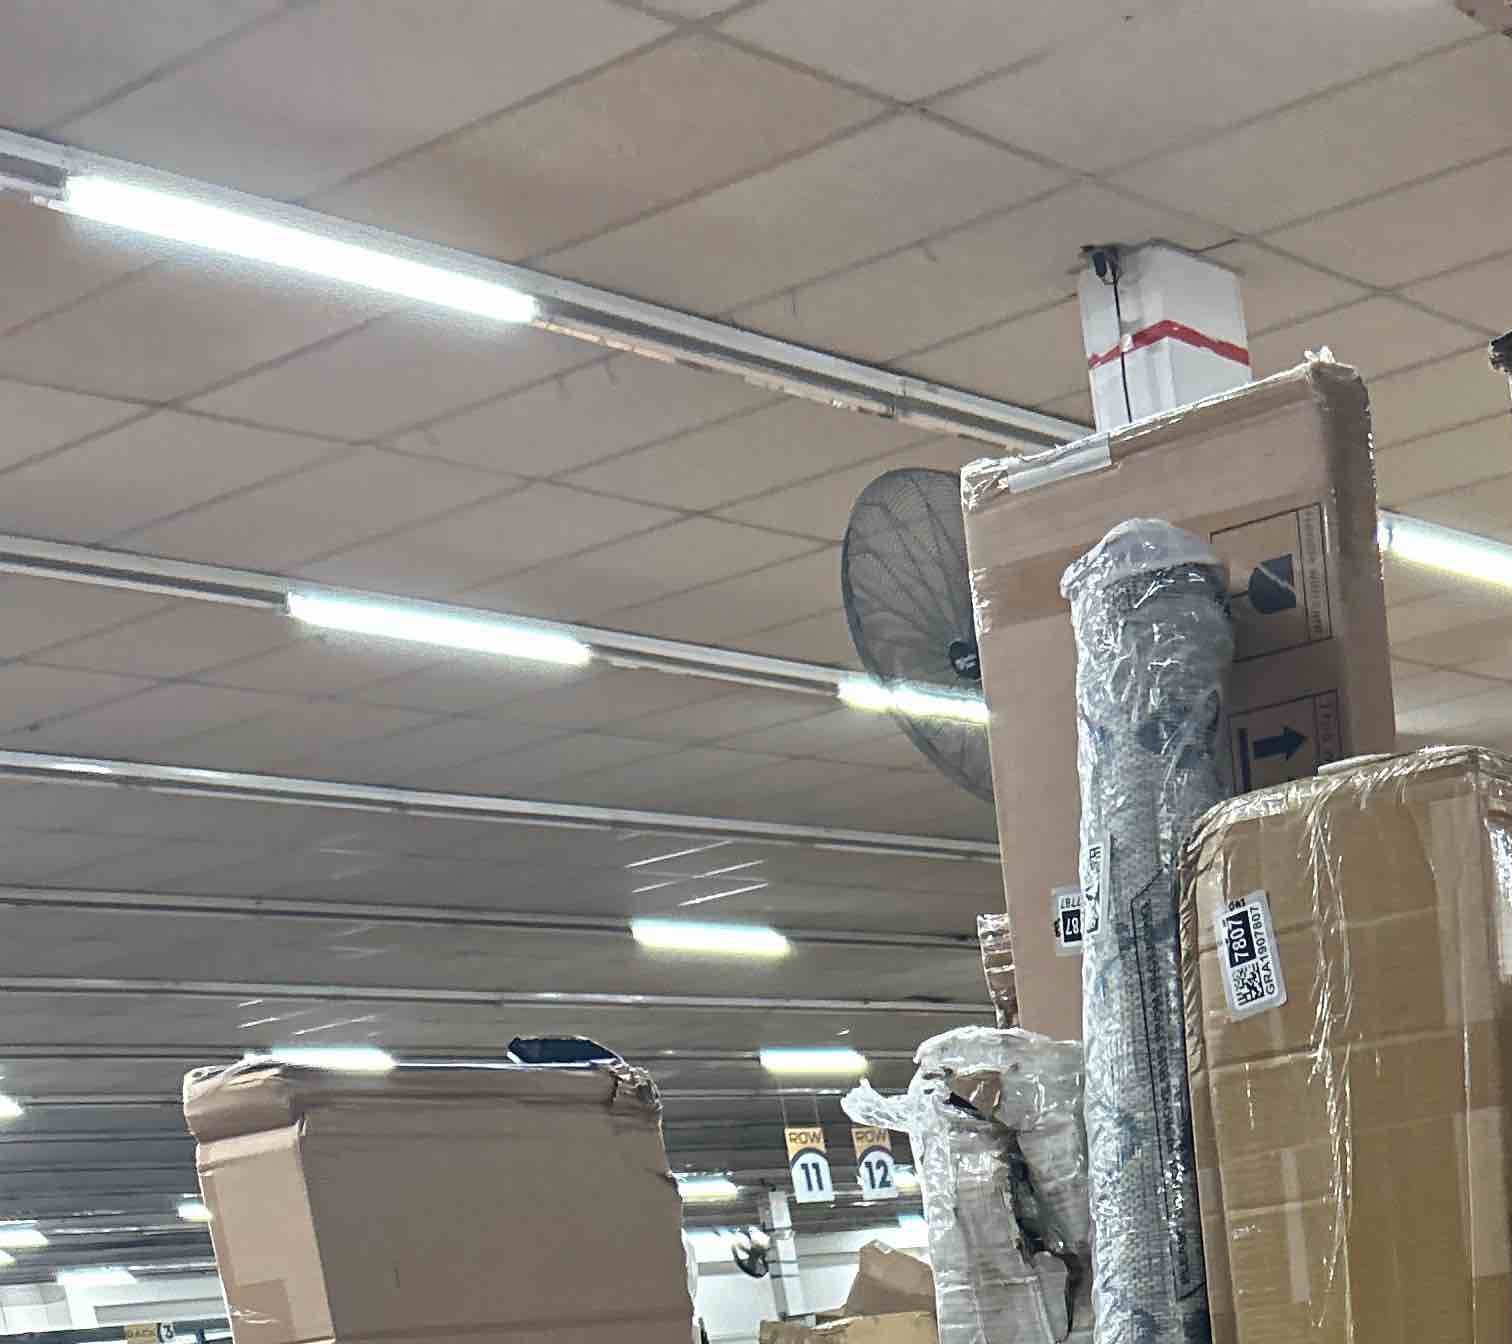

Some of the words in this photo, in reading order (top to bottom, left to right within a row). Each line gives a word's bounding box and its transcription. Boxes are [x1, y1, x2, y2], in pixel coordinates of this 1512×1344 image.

[1229, 917, 1249, 963] 7807
[1252, 905, 1276, 996] GRA1907807
[789, 1131, 821, 1144] ROW
[800, 1162, 824, 1191] 11
[864, 1159, 891, 1190] 12
